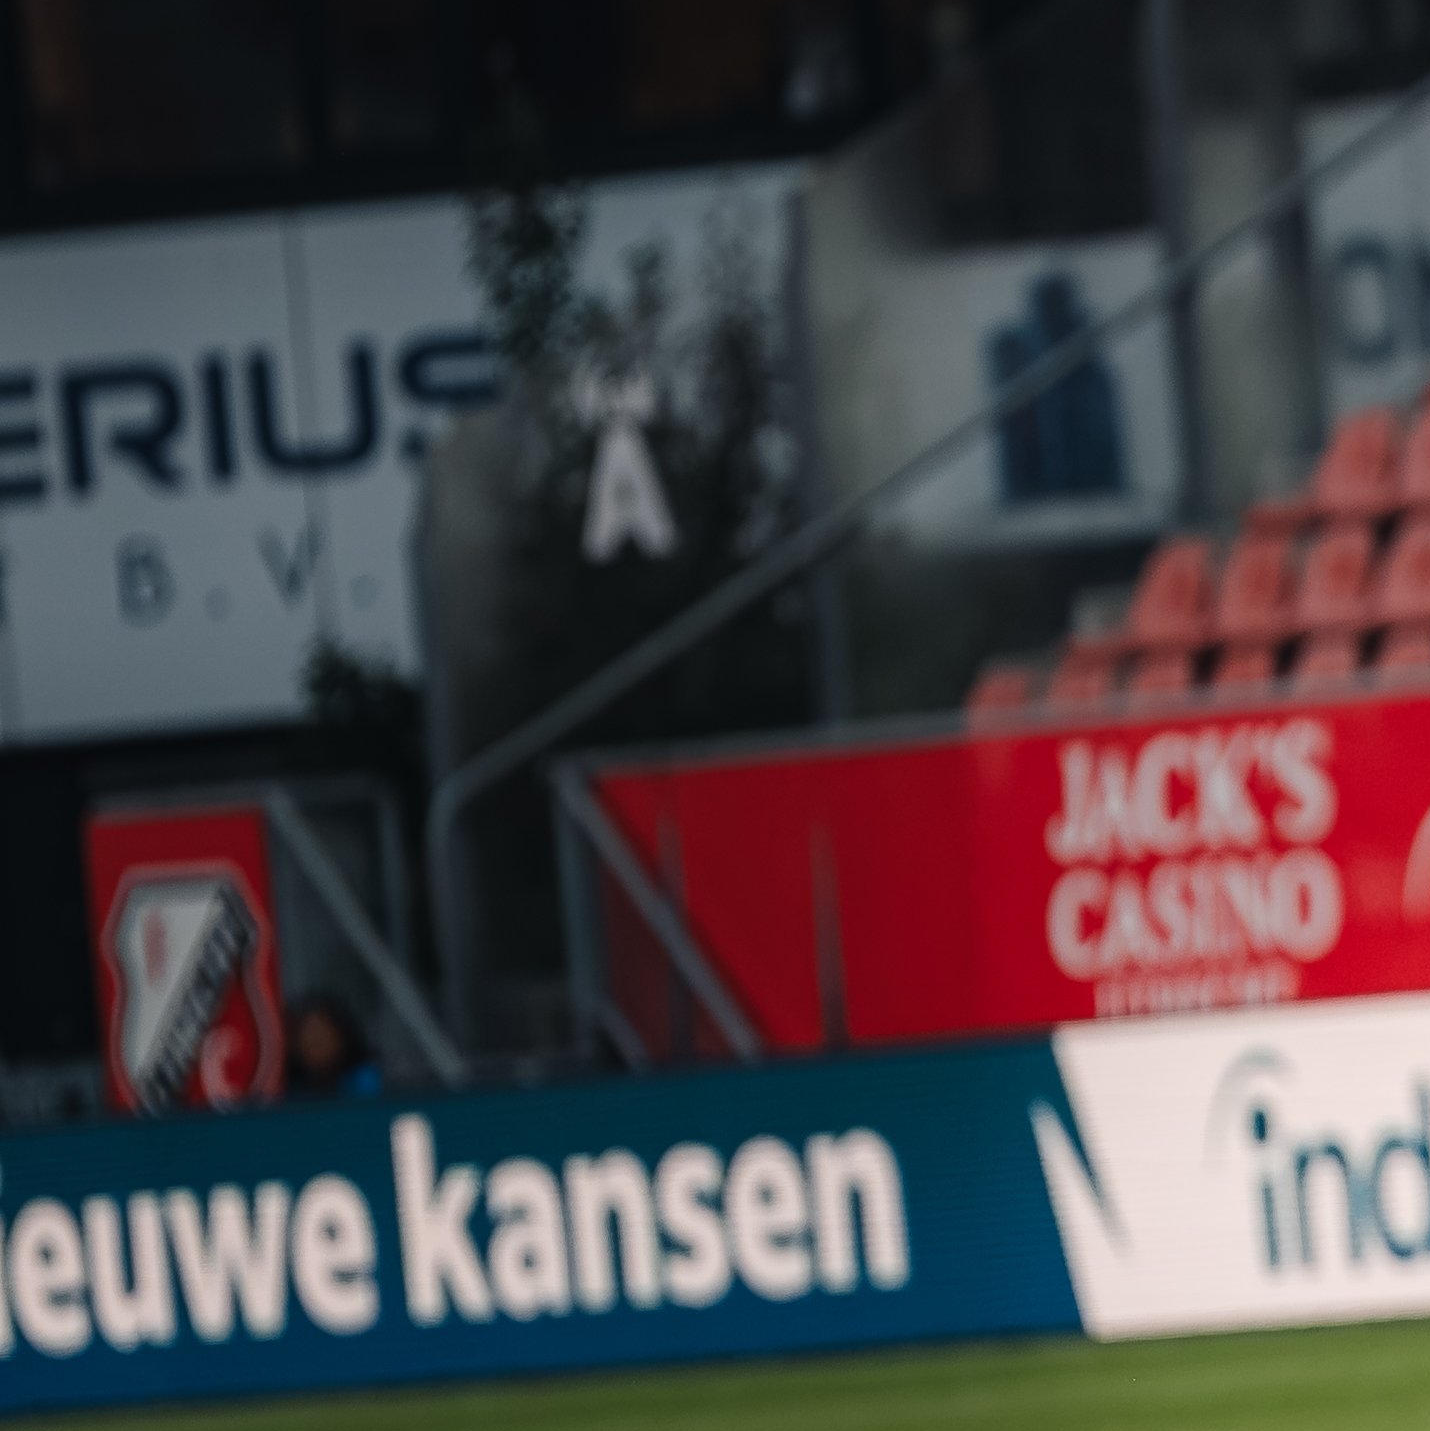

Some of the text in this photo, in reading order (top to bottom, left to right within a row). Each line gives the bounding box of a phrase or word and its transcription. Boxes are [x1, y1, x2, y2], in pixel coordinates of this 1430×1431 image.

[1042, 717, 1340, 868] JACK'S
[1044, 844, 1346, 983] CASINO
[389, 1113, 912, 1328] kansen
